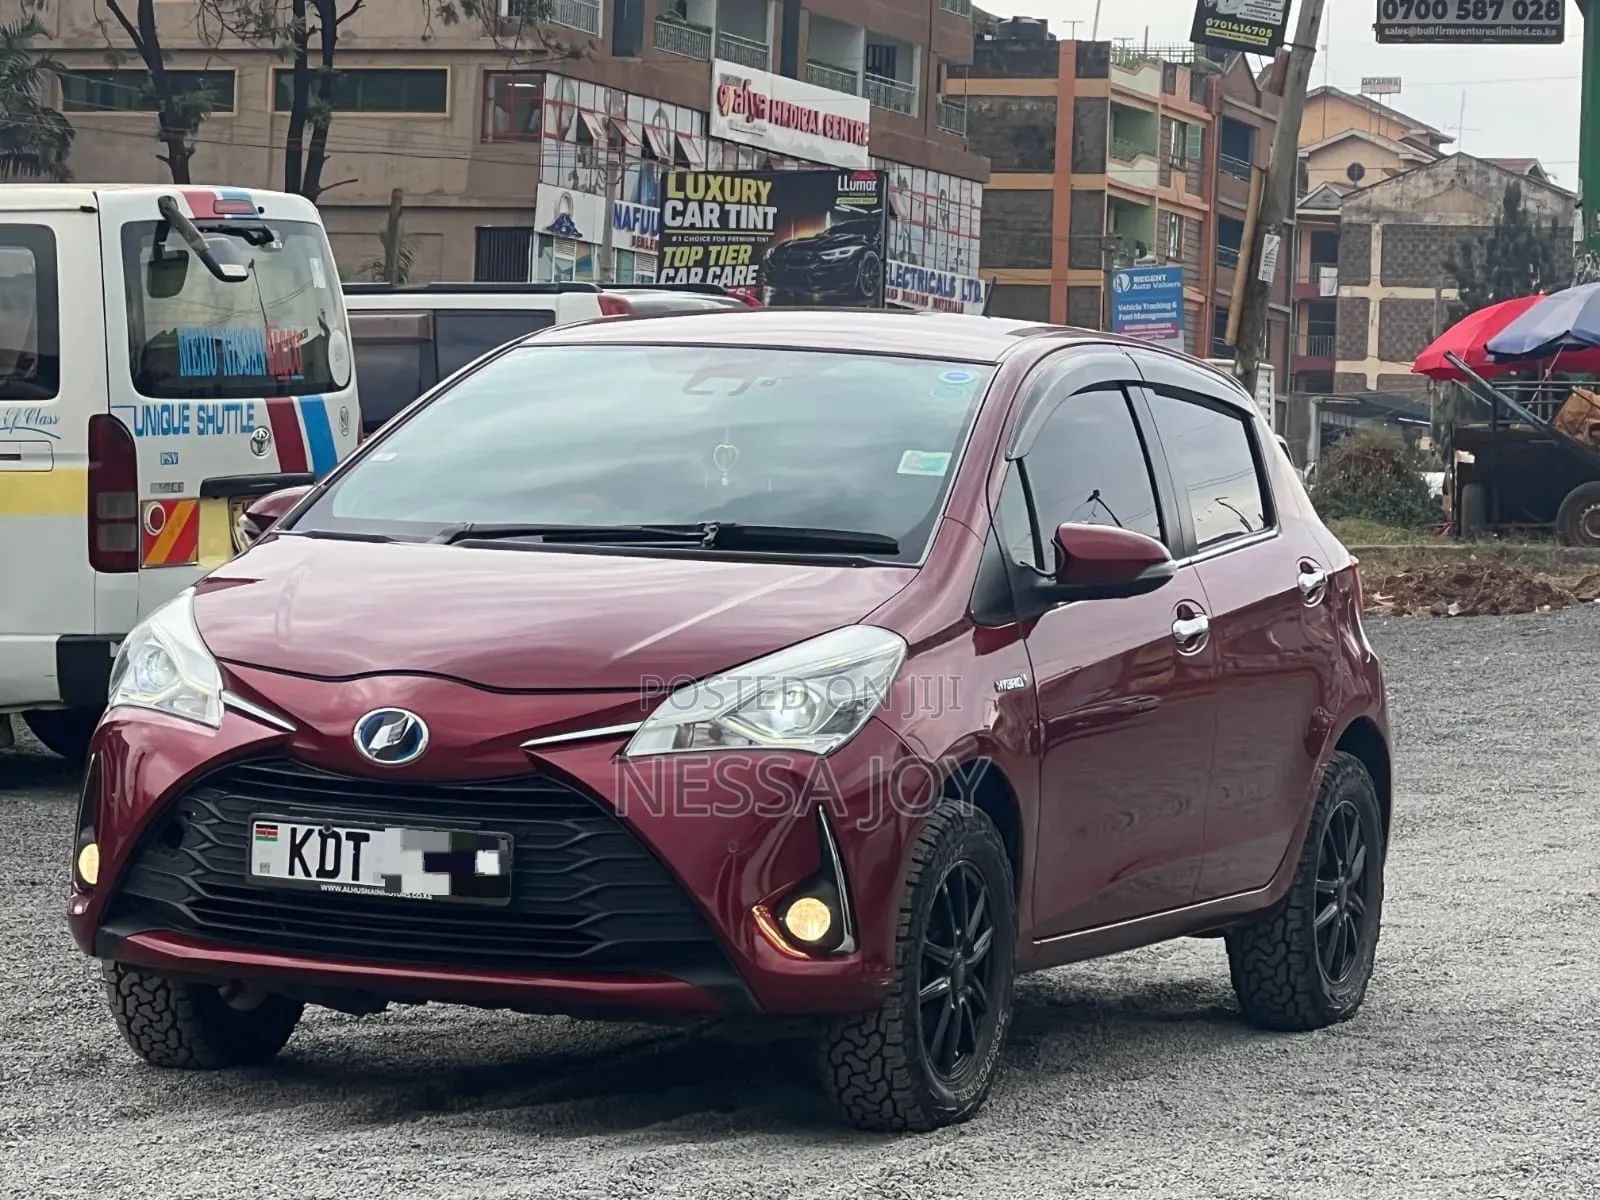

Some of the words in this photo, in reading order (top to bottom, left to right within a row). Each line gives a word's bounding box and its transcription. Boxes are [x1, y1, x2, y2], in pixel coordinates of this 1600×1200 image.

[1383, 0, 1448, 20] 0700
[1456, 0, 1504, 20] 587
[1512, 0, 1561, 20] 028
[1205, 18, 1273, 38] 0701414705
[769, 99, 823, 135] MEDICAL
[823, 113, 869, 146] CENTRE
[667, 171, 772, 205] LUXURY
[612, 203, 660, 237] NAFUU
[664, 200, 720, 228] CAR
[725, 204, 777, 230] TINT
[663, 246, 704, 267] TOP
[708, 244, 752, 266] TIER
[660, 267, 703, 285] CAR
[706, 265, 759, 288] CARE
[886, 262, 956, 299] LECTRICALS
[1118, 303, 1142, 311] Vehicle
[1143, 302, 1171, 310] Tracking
[178, 327, 218, 377] MERU
[221, 327, 266, 377] NISSAN
[134, 403, 190, 437] UNIQUE
[197, 403, 255, 435] SHUTTLE
[160, 452, 178, 465] PSV
[288, 826, 371, 882] KDT
